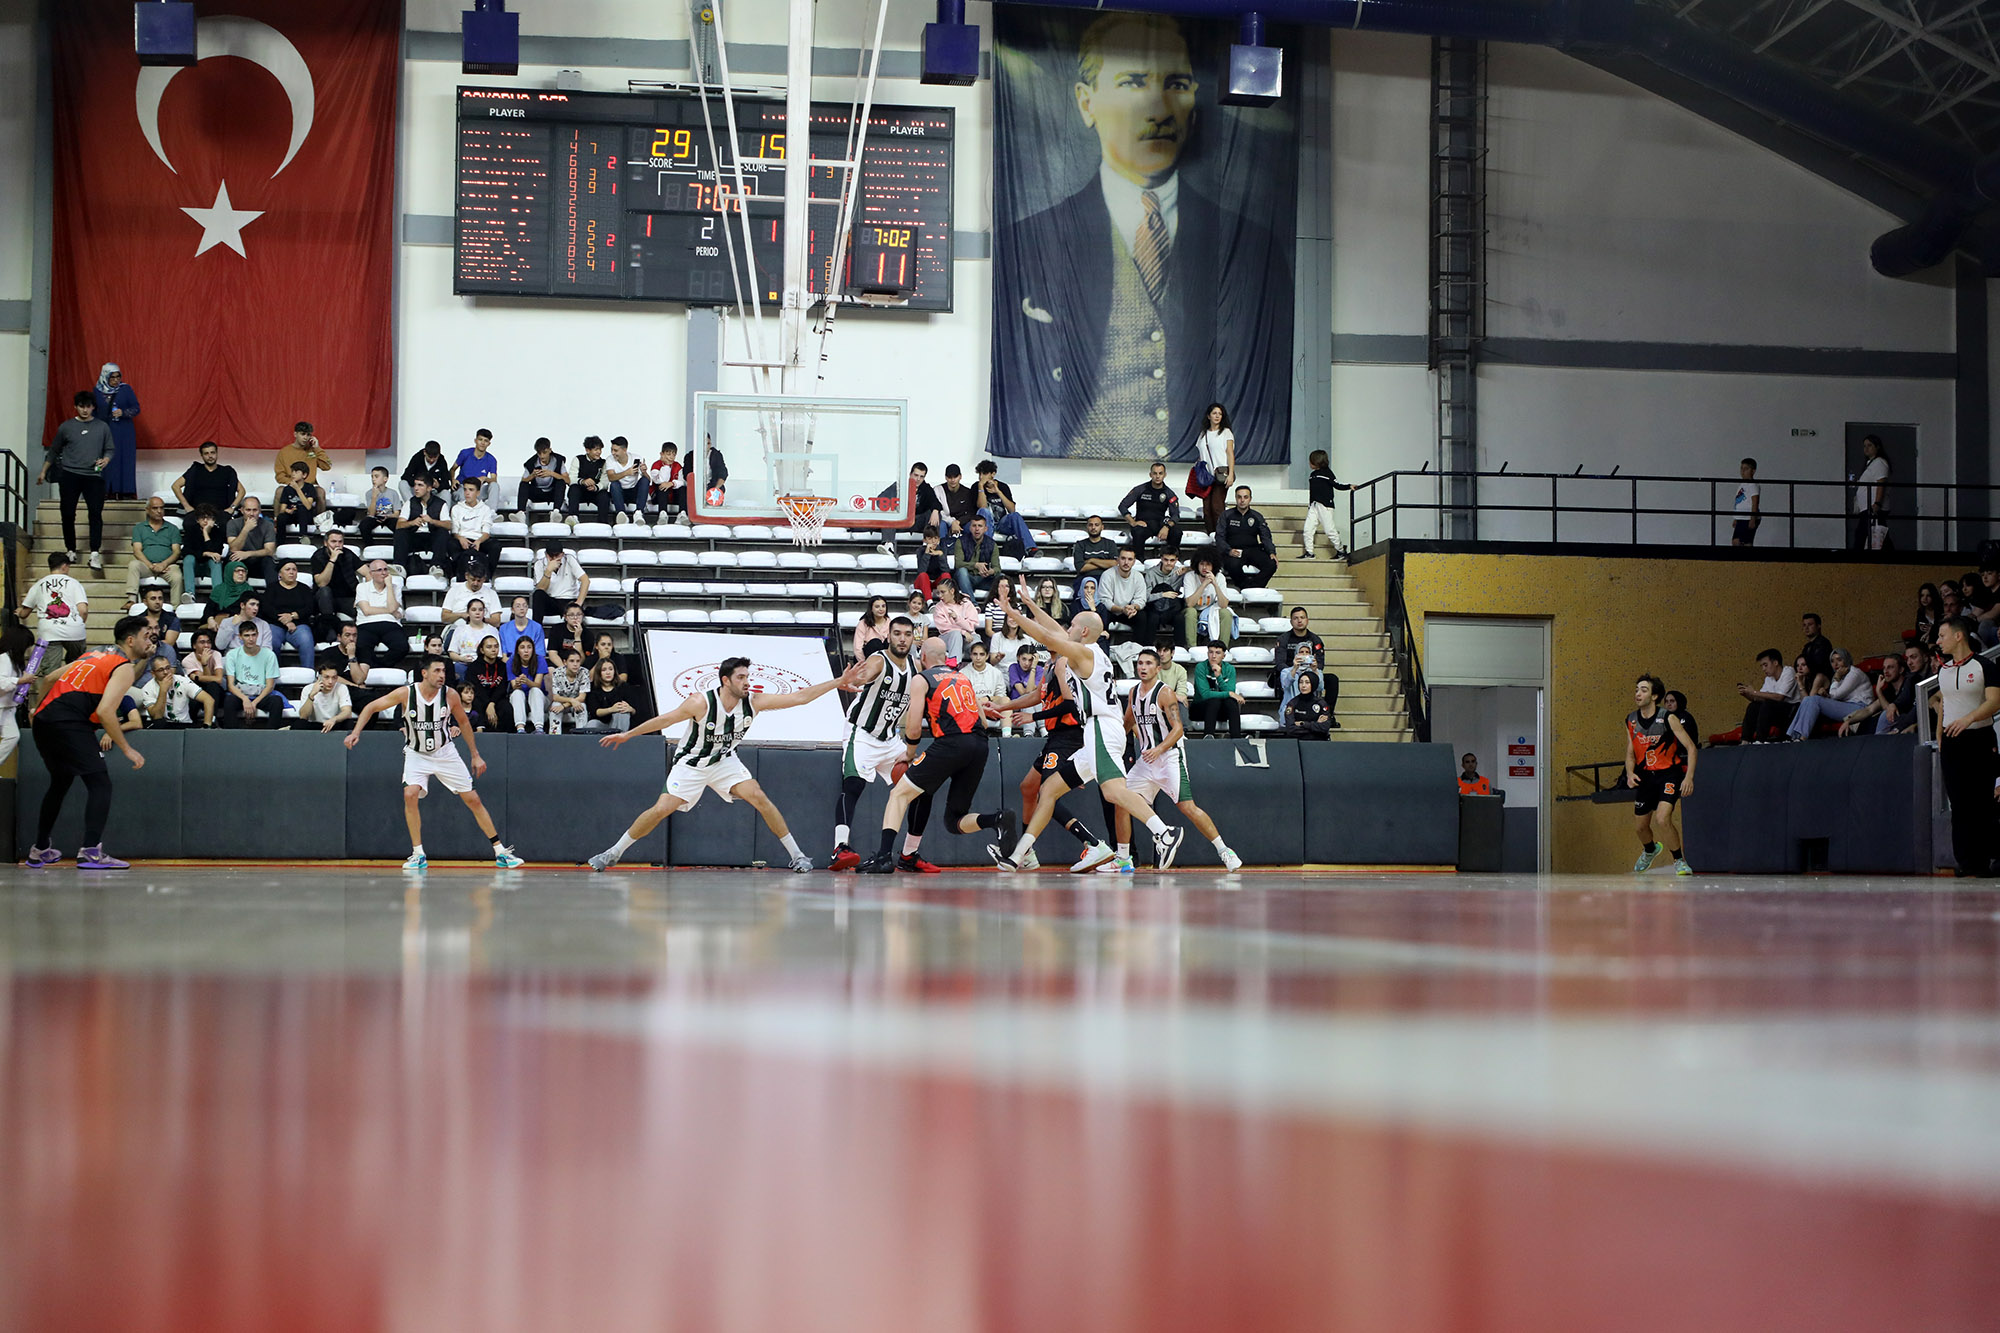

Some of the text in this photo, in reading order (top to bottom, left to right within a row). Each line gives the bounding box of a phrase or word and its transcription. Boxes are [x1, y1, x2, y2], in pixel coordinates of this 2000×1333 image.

[489, 108, 525, 117] PLAYER
[574, 129, 579, 140] 1
[890, 126, 925, 136] PLAYER
[569, 142, 597, 154] 4 7
[652, 129, 691, 158] 29
[759, 134, 786, 159] 15
[569, 154, 617, 169] 6 2
[649, 157, 673, 169] SCORE
[743, 163, 768, 172] SCORE
[569, 167, 597, 180] 8 3
[697, 170, 716, 180] TIME
[826, 166, 834, 179] 3
[569, 180, 616, 195] 9 9 1
[569, 193, 577, 206] 2
[569, 206, 577, 219] 5
[568, 219, 596, 233] 9 2
[646, 214, 777, 242] 1 2 1
[568, 232, 616, 247] 3 2 2
[874, 228, 911, 248] 7:02
[568, 245, 595, 259] 8 2
[695, 246, 719, 257] PERIOD
[568, 258, 616, 272] 5 4 1
[877, 252, 906, 285] 11
[568, 272, 576, 284] 4
[868, 497, 900, 512] TBF
[40, 578, 69, 593] TRUST
[941, 684, 979, 713] 10
[884, 705, 902, 721] 35
[426, 738, 435, 750] 9
[706, 732, 733, 743] SAKARYA
[1646, 749, 1657, 767] 5
